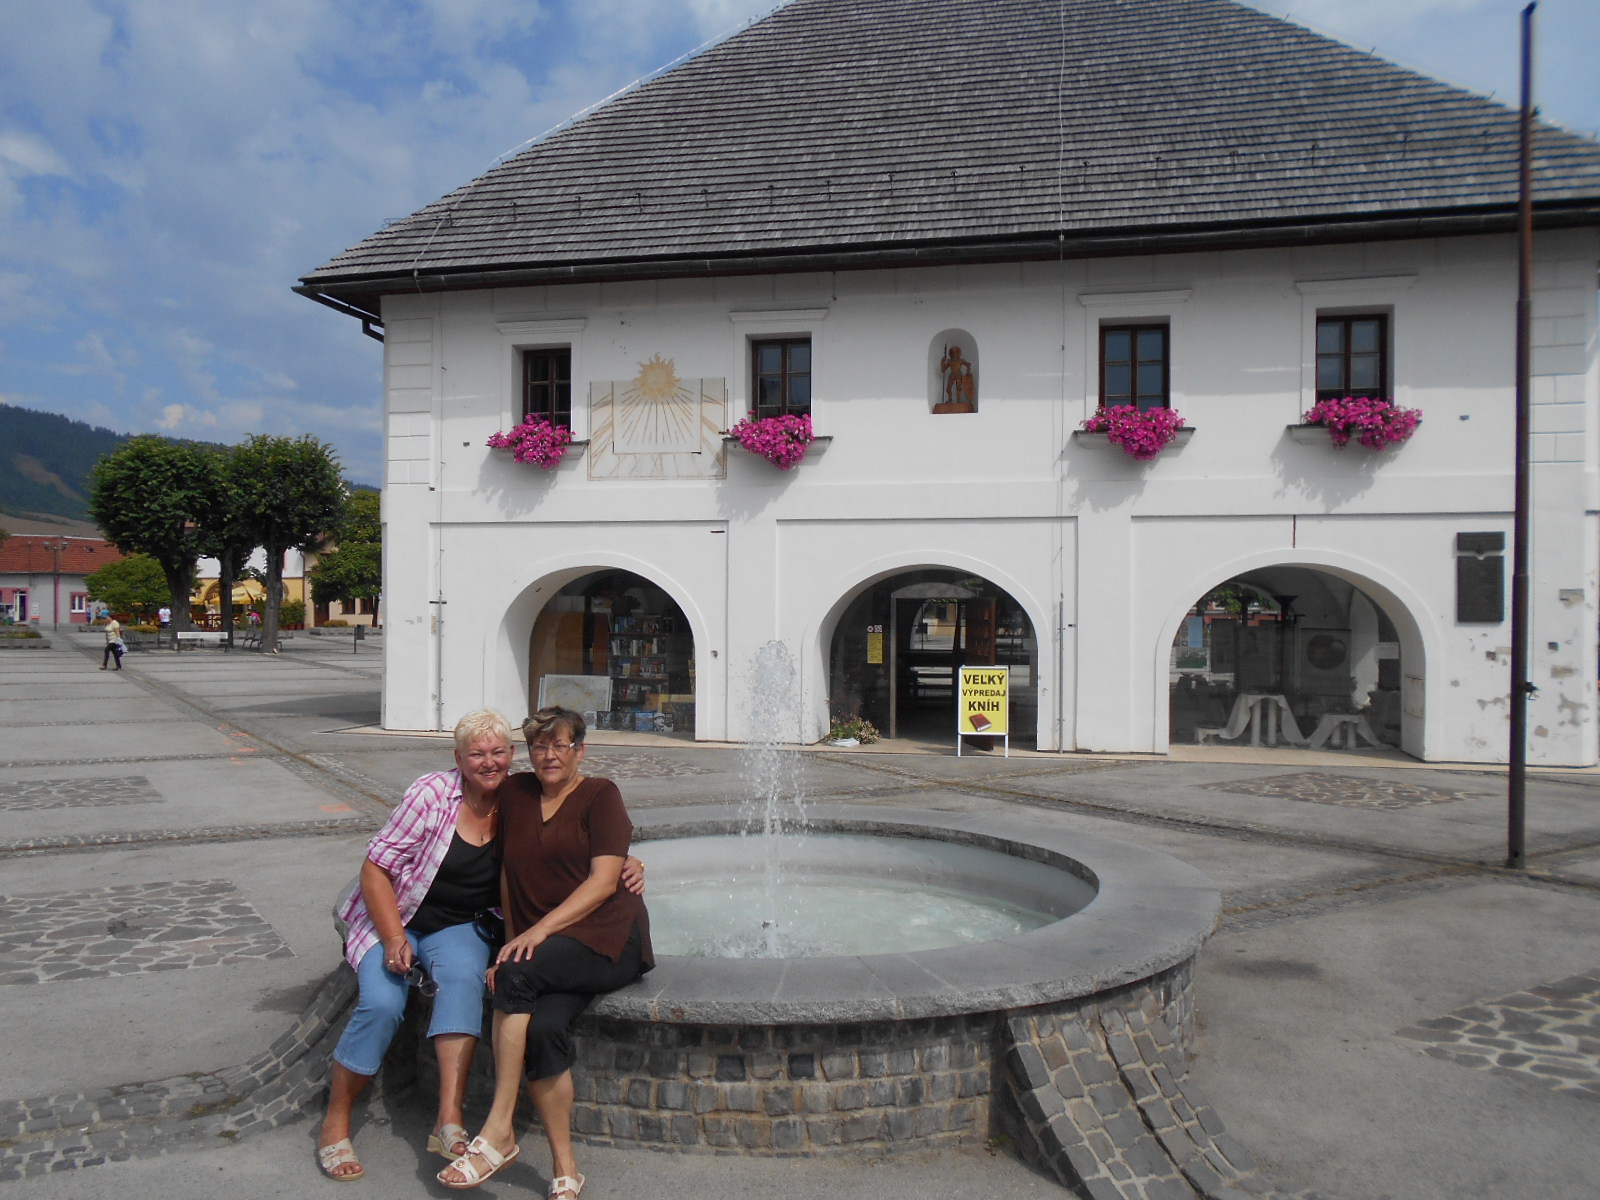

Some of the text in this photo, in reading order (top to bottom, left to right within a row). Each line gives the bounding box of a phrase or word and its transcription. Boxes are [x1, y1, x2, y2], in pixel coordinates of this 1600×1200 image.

[963, 672, 1005, 685] VEĽKÝ
[962, 688, 1006, 697] VÝPREDAJ
[968, 699, 1000, 711] KNÍH
